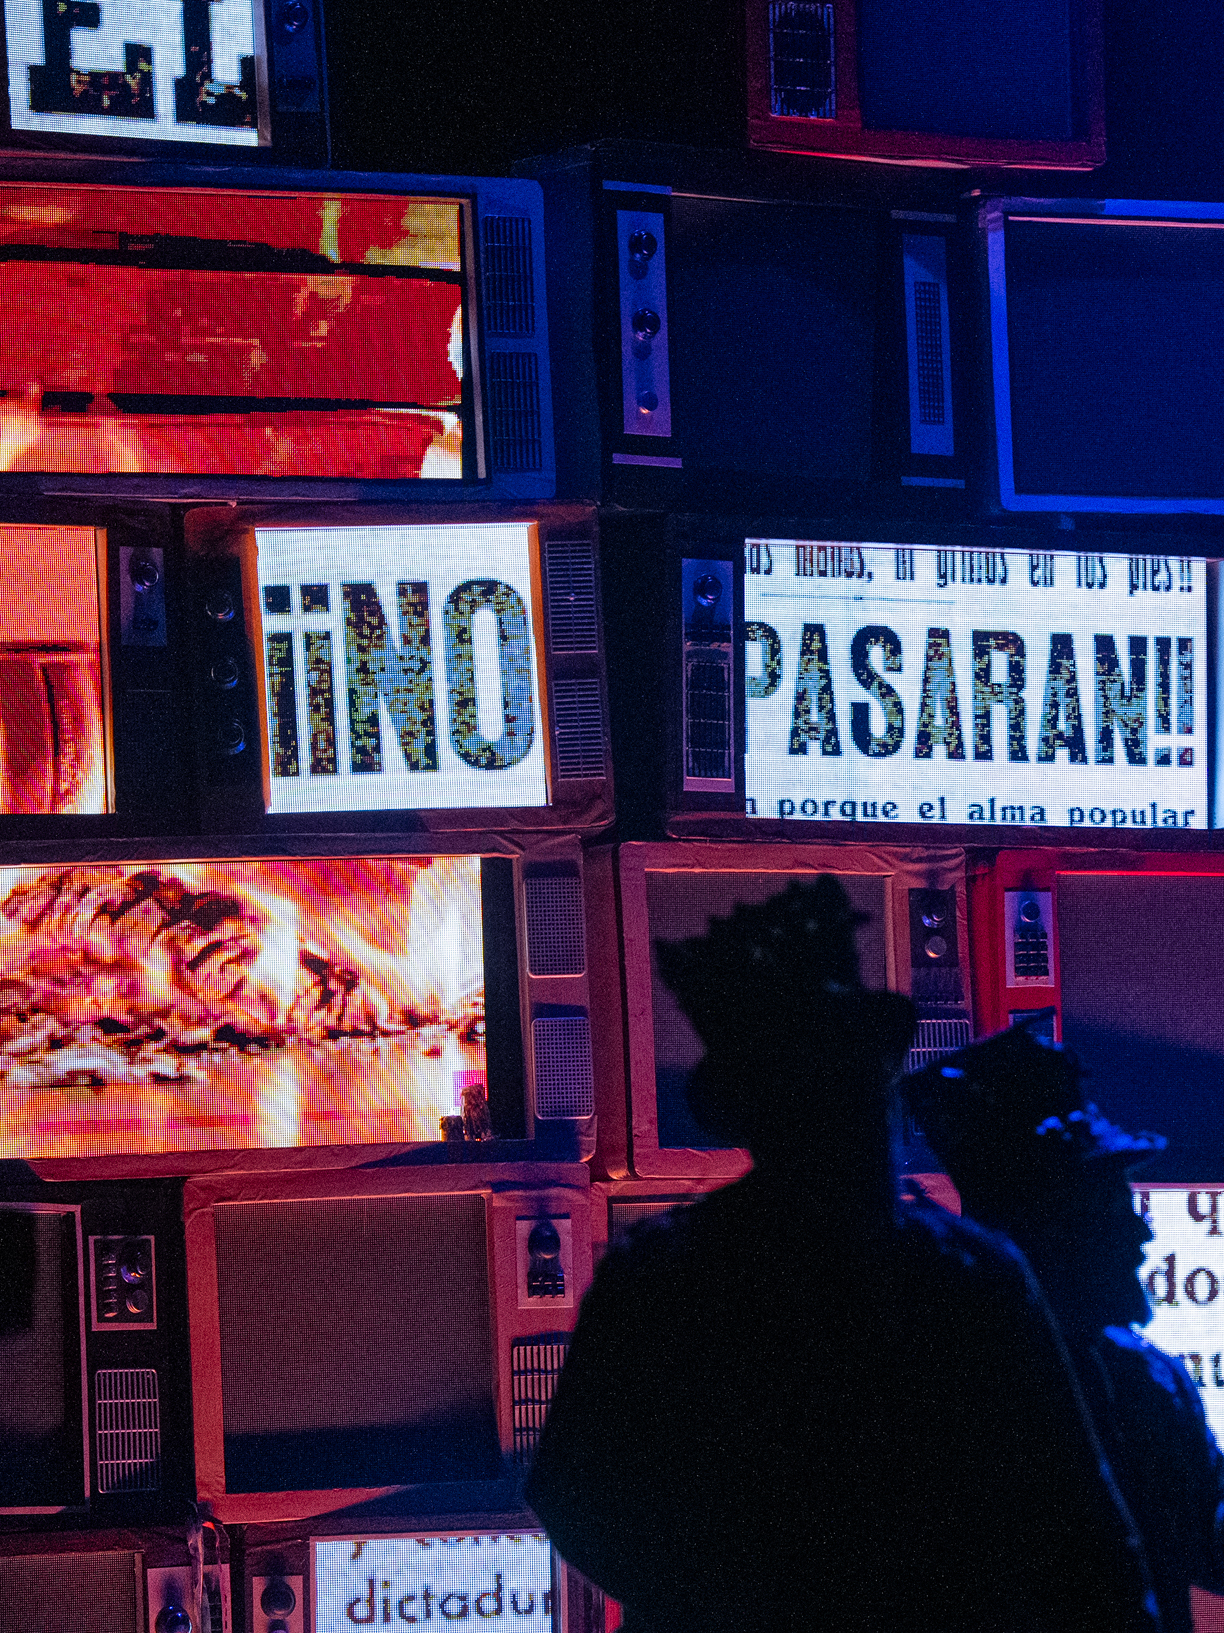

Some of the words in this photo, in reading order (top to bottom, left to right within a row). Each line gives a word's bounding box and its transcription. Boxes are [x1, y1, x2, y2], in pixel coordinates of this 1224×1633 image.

[745, 621, 1195, 768] PASARAN!!
[779, 798, 897, 821] porque
[919, 796, 947, 819] el
[968, 797, 1046, 823] alma
[1067, 802, 1195, 828] popular
